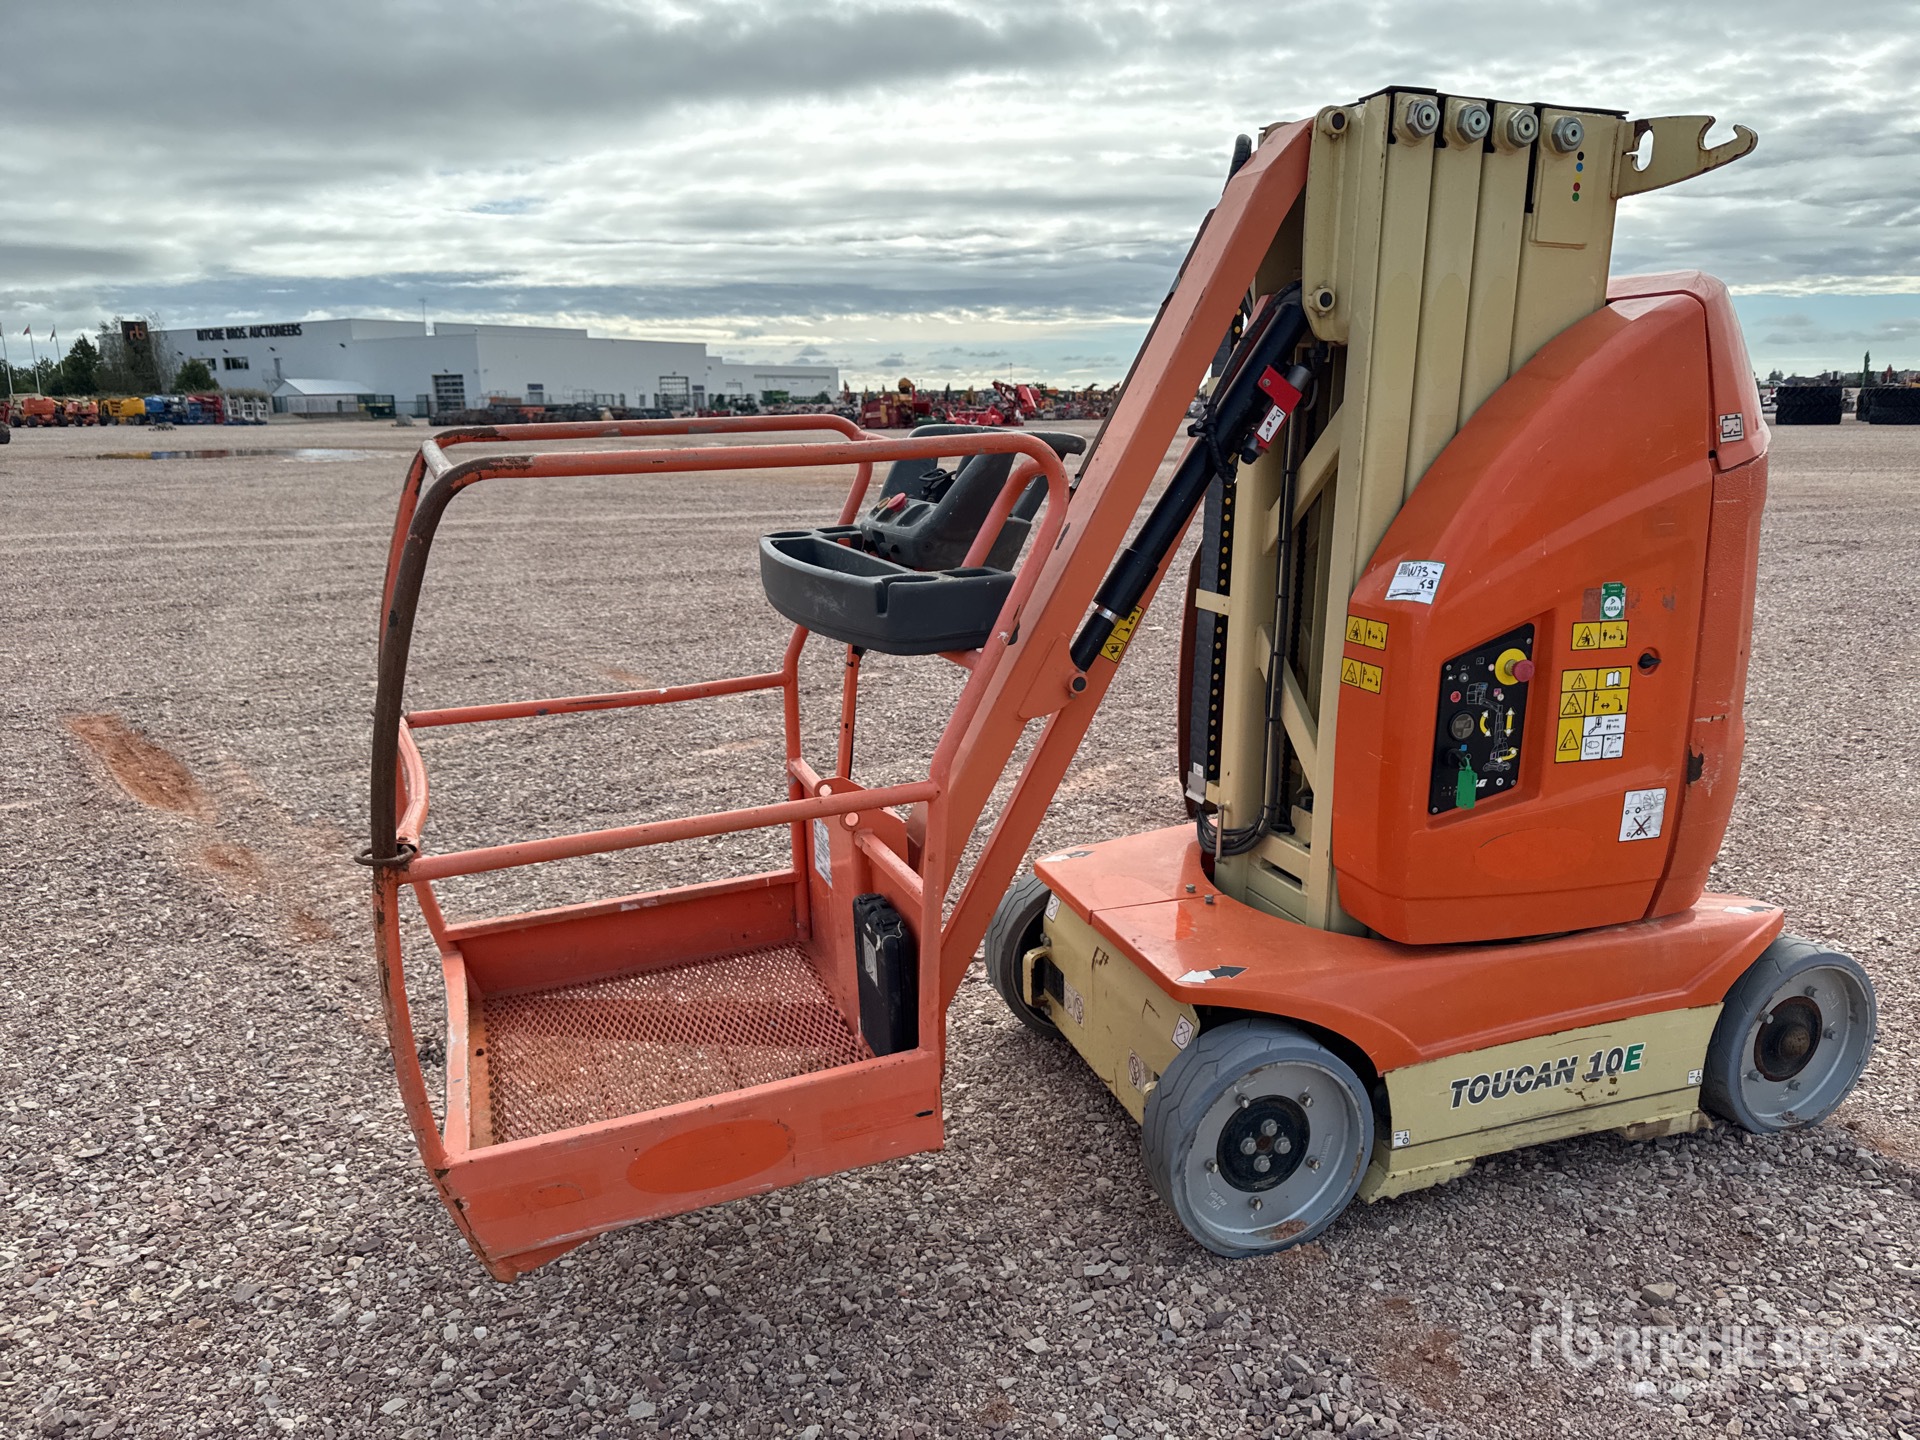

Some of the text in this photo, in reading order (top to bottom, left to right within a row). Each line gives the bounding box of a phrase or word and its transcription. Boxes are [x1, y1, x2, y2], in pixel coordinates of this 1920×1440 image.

[249, 323, 302, 338] AUCTIONEERS
[1450, 1042, 1646, 1110] TOUCAN 10E
